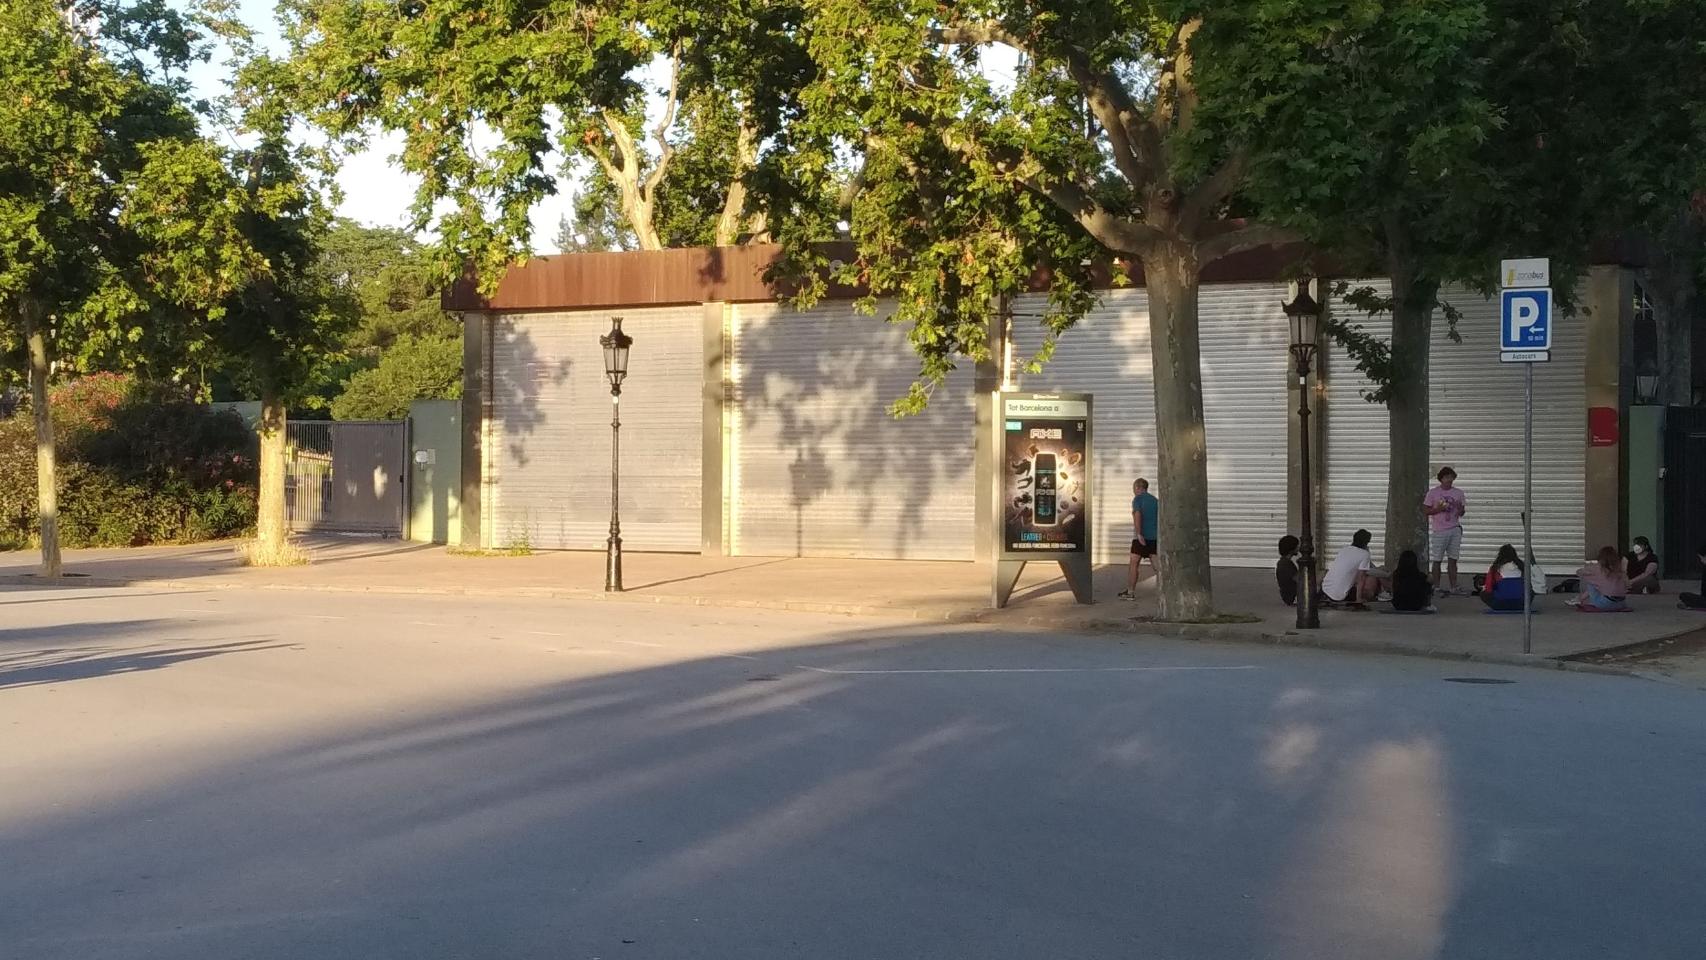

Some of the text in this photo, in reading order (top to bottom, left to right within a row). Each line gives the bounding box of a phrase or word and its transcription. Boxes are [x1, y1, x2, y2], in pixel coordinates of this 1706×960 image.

[1511, 297, 1539, 342] P
[1008, 403, 1018, 411] Tot
[1019, 403, 1053, 412] Barcelona
[1030, 429, 1062, 439] AXE
